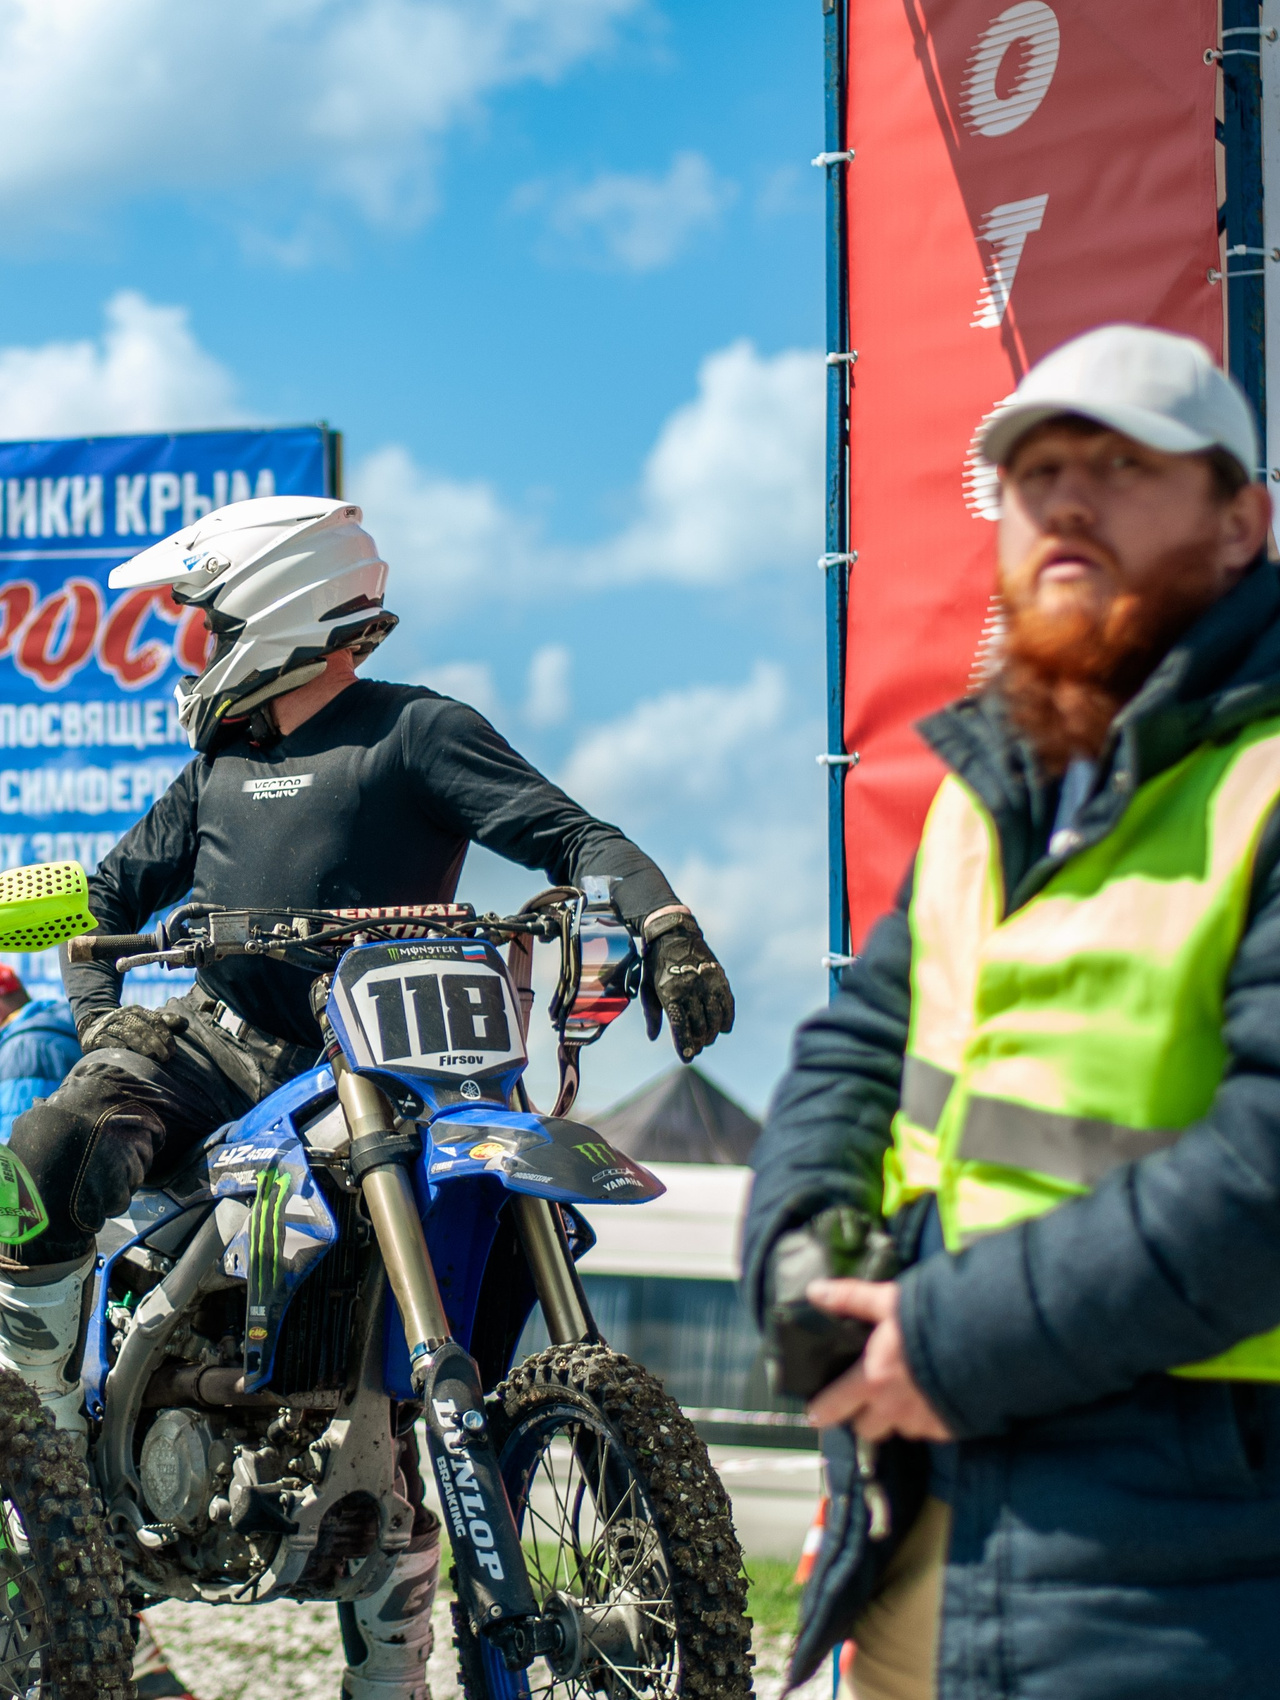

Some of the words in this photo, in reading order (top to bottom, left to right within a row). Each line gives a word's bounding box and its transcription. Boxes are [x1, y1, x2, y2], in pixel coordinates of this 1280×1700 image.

[366, 973, 512, 1062] 118
[438, 1054, 484, 1067] Firsov
[602, 1177, 645, 1192] YAMAHA
[432, 1398, 505, 1581] DUNLOP
[435, 1454, 467, 1538] BRAKING
